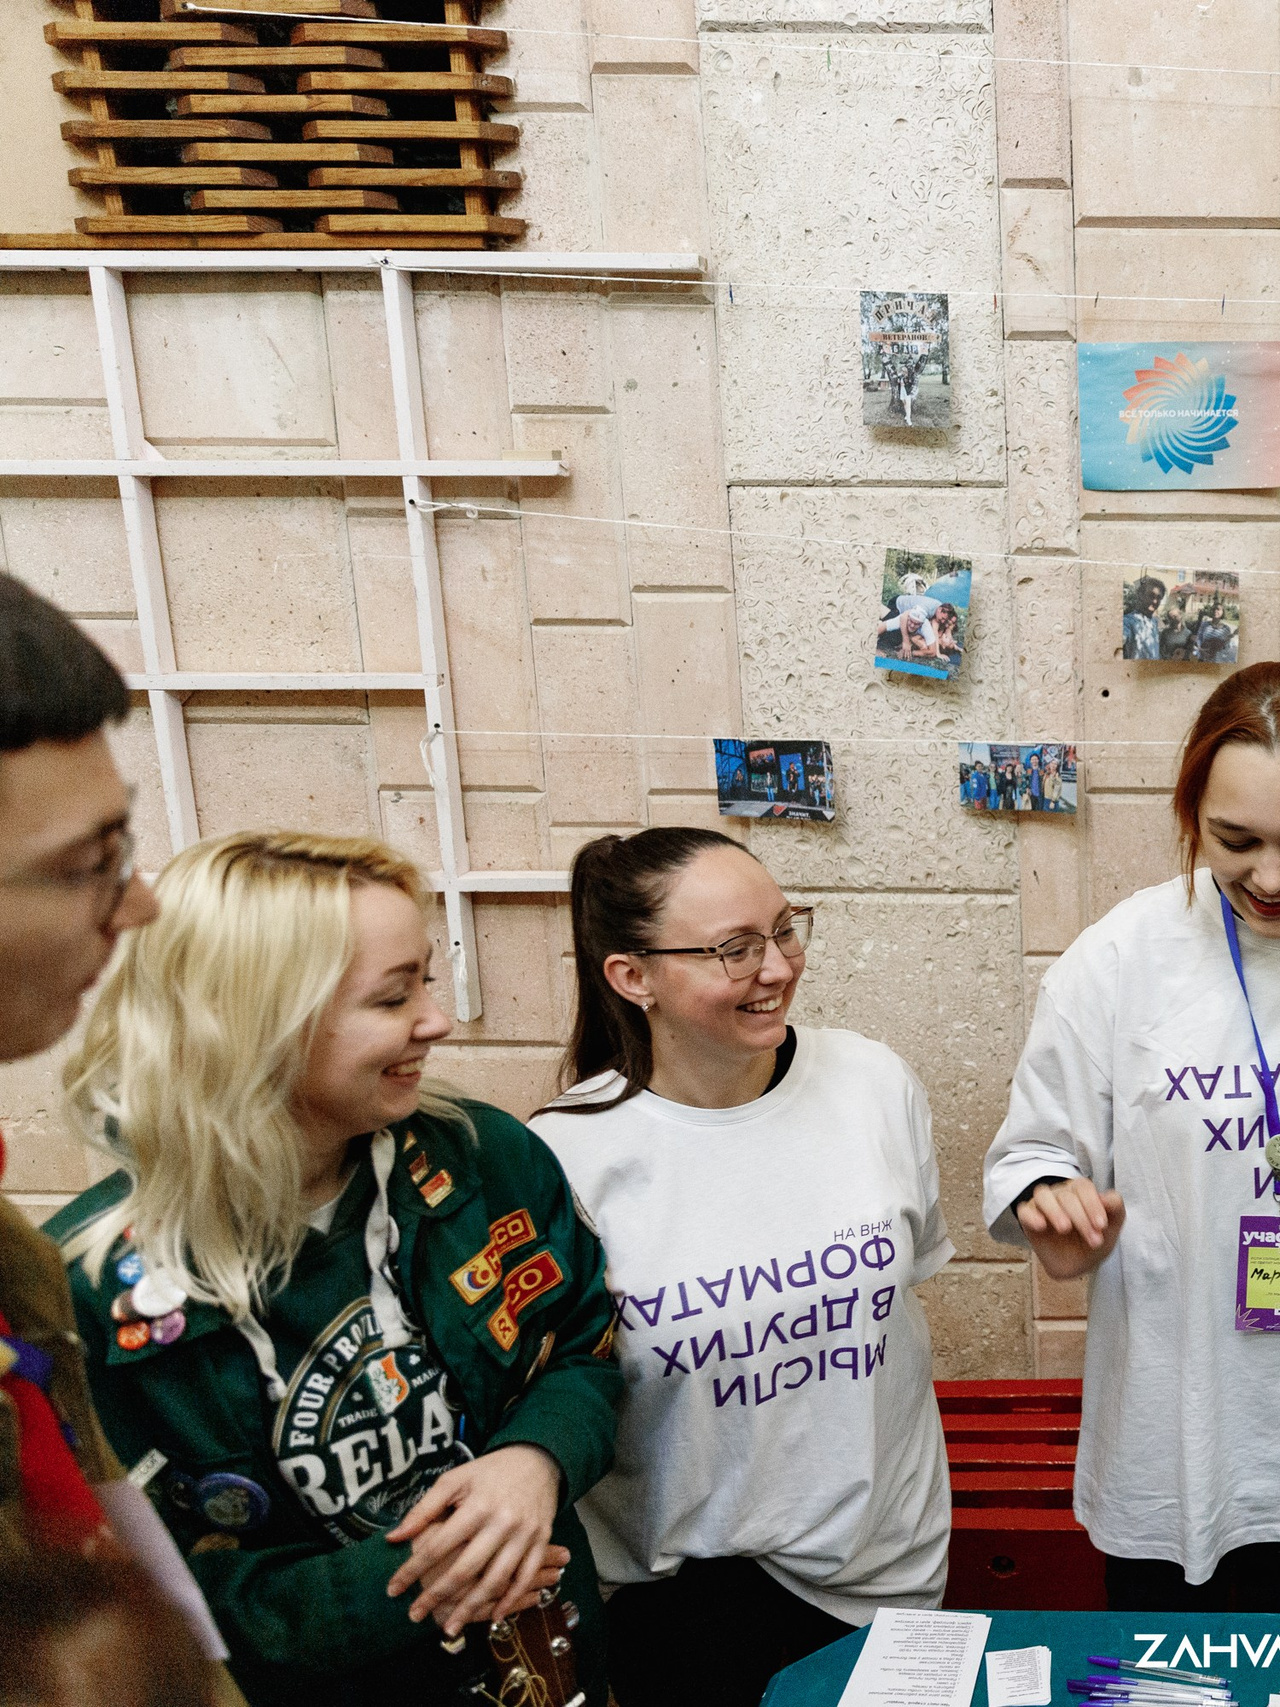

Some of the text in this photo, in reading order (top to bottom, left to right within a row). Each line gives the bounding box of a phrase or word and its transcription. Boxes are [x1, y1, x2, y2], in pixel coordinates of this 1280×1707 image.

[1139, 409, 1177, 418] ТОЛЬКО
[1177, 408, 1239, 418] НАЧИНАЕТСЯ
[833, 1218, 893, 1242] НА ВНЖ
[651, 1284, 896, 1378] В ДРУГИХ
[713, 1333, 887, 1408] МЫСЛИ
[288, 1373, 336, 1449] FOUR
[339, 1408, 379, 1429] TRADE
